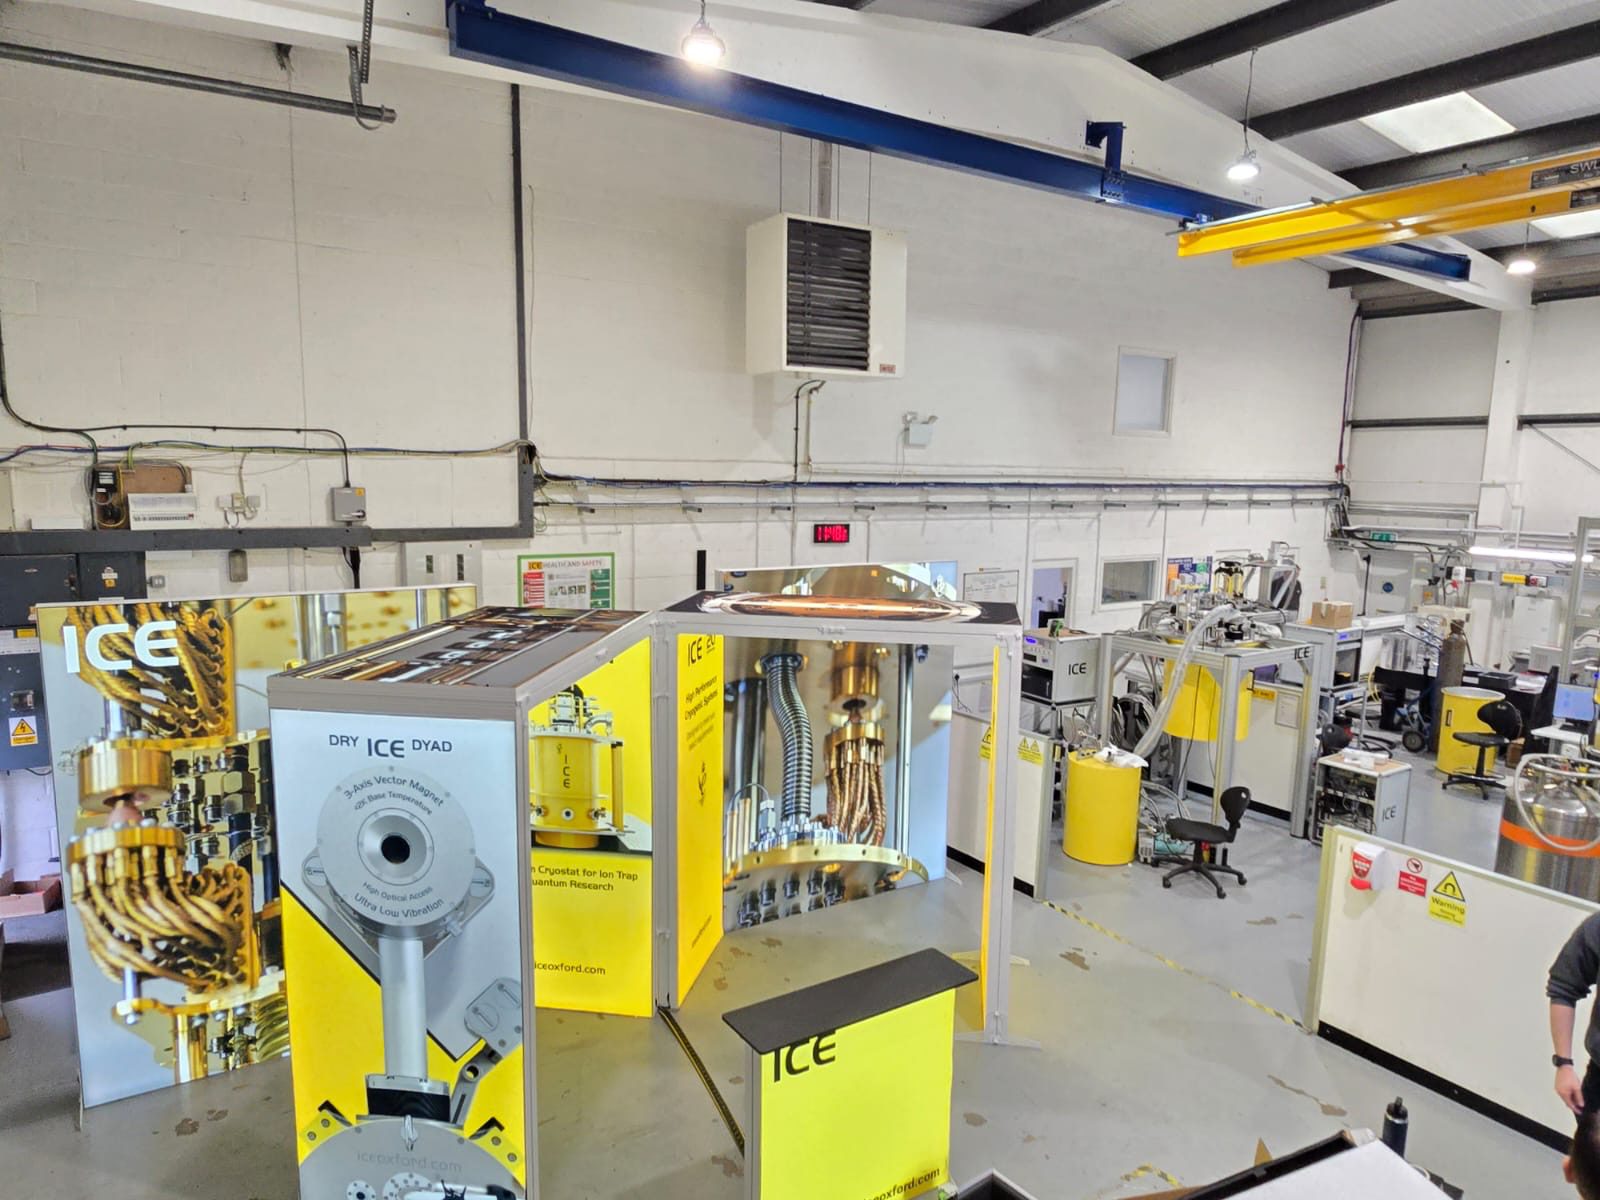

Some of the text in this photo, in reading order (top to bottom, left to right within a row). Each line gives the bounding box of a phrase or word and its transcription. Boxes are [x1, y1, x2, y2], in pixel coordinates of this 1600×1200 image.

[62, 620, 180, 673] ICE
[687, 637, 703, 667] ICE
[1294, 646, 1310, 660] ICE
[1068, 662, 1087, 675] ICE
[328, 734, 453, 758] DRY ICE DYAD
[563, 754, 571, 789] ICE
[343, 775, 444, 807] 3-Axis Vector Magnet
[367, 792, 386, 802] Base
[387, 790, 432, 815] Temperature
[1382, 804, 1397, 822] ICE
[538, 865, 580, 876] Cryostat
[582, 868, 597, 877] for
[599, 869, 614, 879] Ion
[616, 870, 638, 882] Trap
[362, 882, 433, 902] High Optical Access
[532, 879, 614, 891] uantum Research
[354, 892, 445, 918] Ultra Low Vibration
[1431, 896, 1465, 915] Warning
[534, 961, 606, 976] iceoxford.com
[773, 1030, 836, 1083] ICE
[356, 1151, 462, 1173] iceoxford.com
